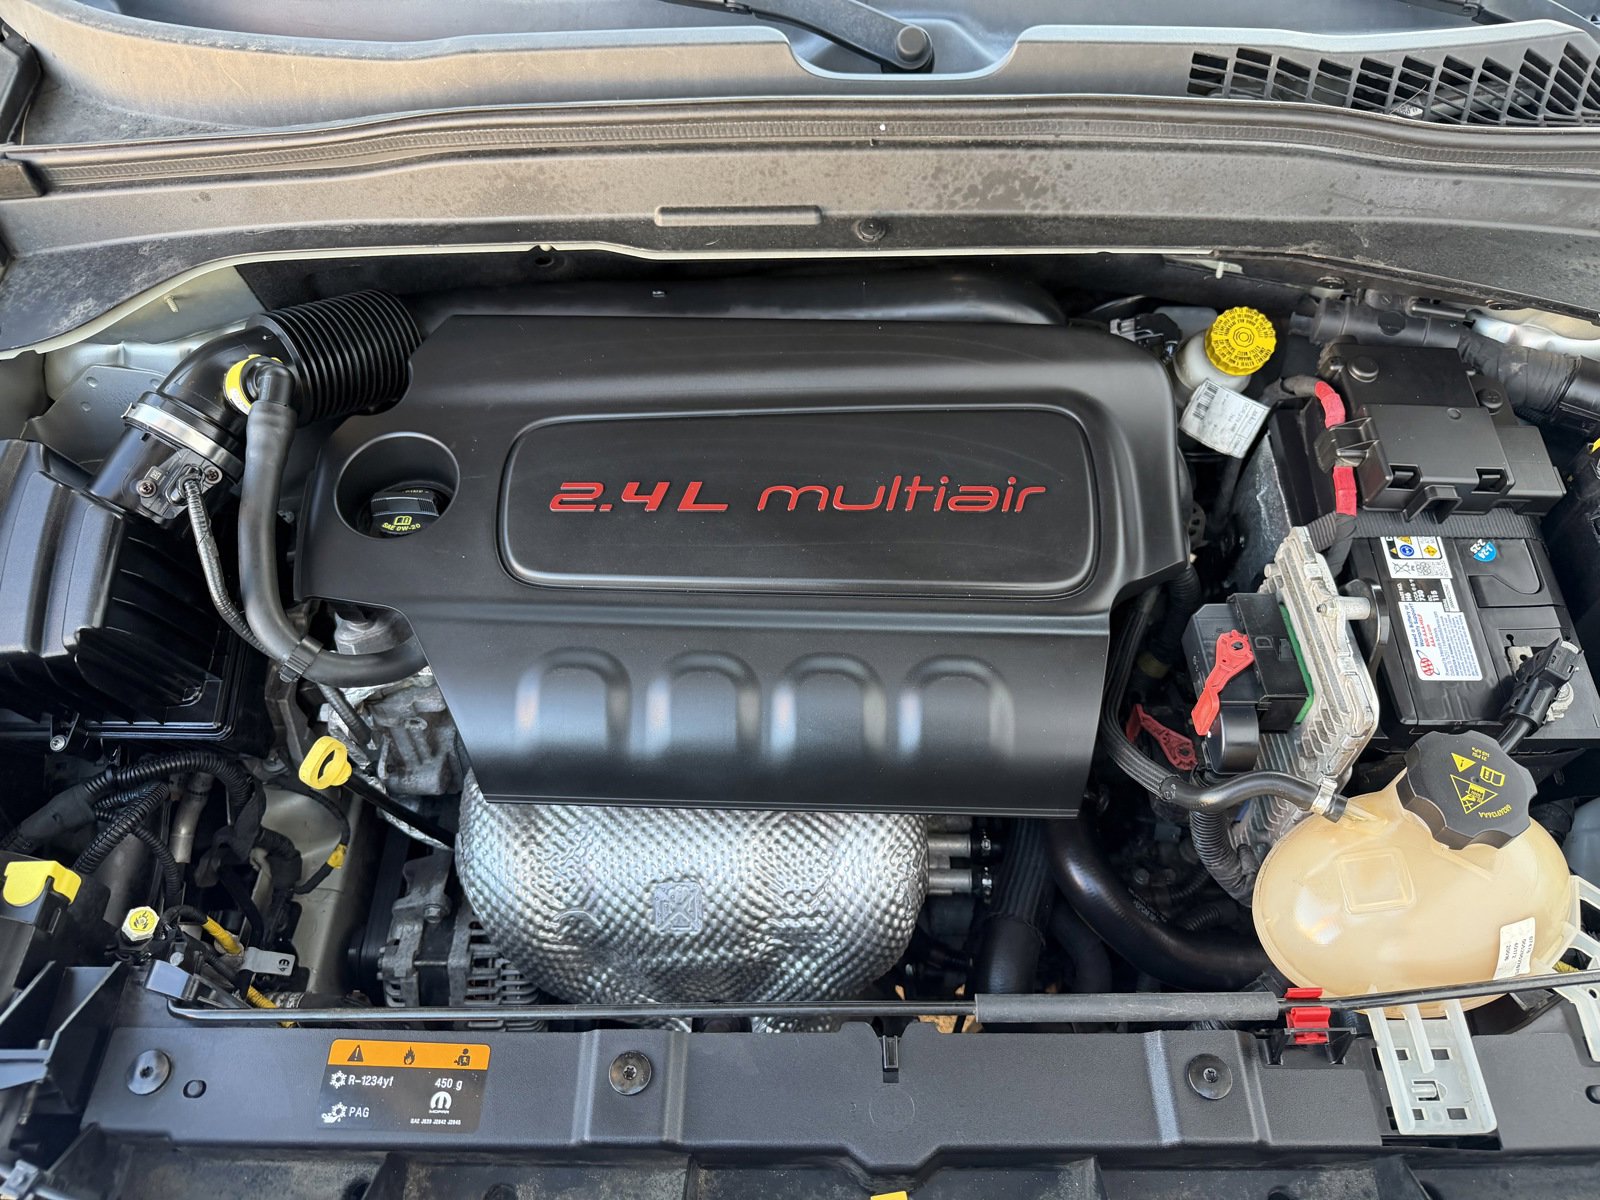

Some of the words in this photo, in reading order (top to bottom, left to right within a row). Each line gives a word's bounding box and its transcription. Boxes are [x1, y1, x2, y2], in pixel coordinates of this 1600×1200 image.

[549, 481, 729, 512] 2.4L
[756, 476, 1047, 513] multiair
[1430, 590, 1440, 601] 115
[348, 1075, 394, 1088] R-1234yf
[435, 1078, 453, 1088] 450
[455, 1081, 463, 1091] g
[348, 1107, 370, 1118] PAG
